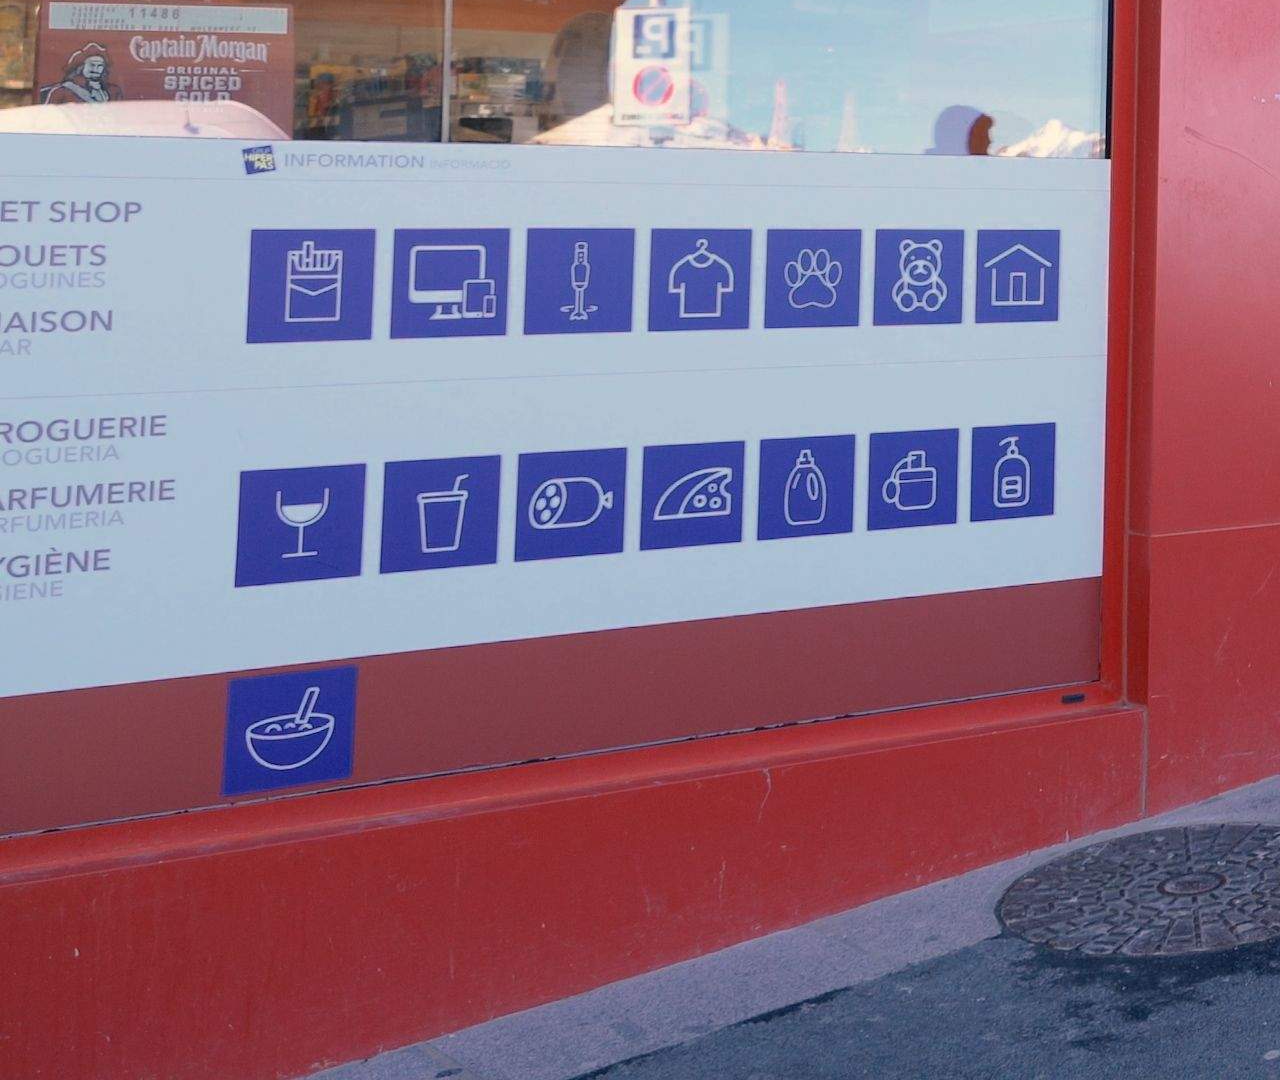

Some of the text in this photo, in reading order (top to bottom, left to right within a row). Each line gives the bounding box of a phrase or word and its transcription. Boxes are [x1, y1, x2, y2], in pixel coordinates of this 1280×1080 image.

[129, 34, 268, 64] Captain Morgan
[166, 66, 239, 75] ORIGINAL
[164, 75, 242, 91] SPICED
[284, 153, 425, 169] INFORMATION
[48, 201, 142, 223] SHOP
[0, 309, 113, 334] AISON
[0, 579, 64, 603] IENE
